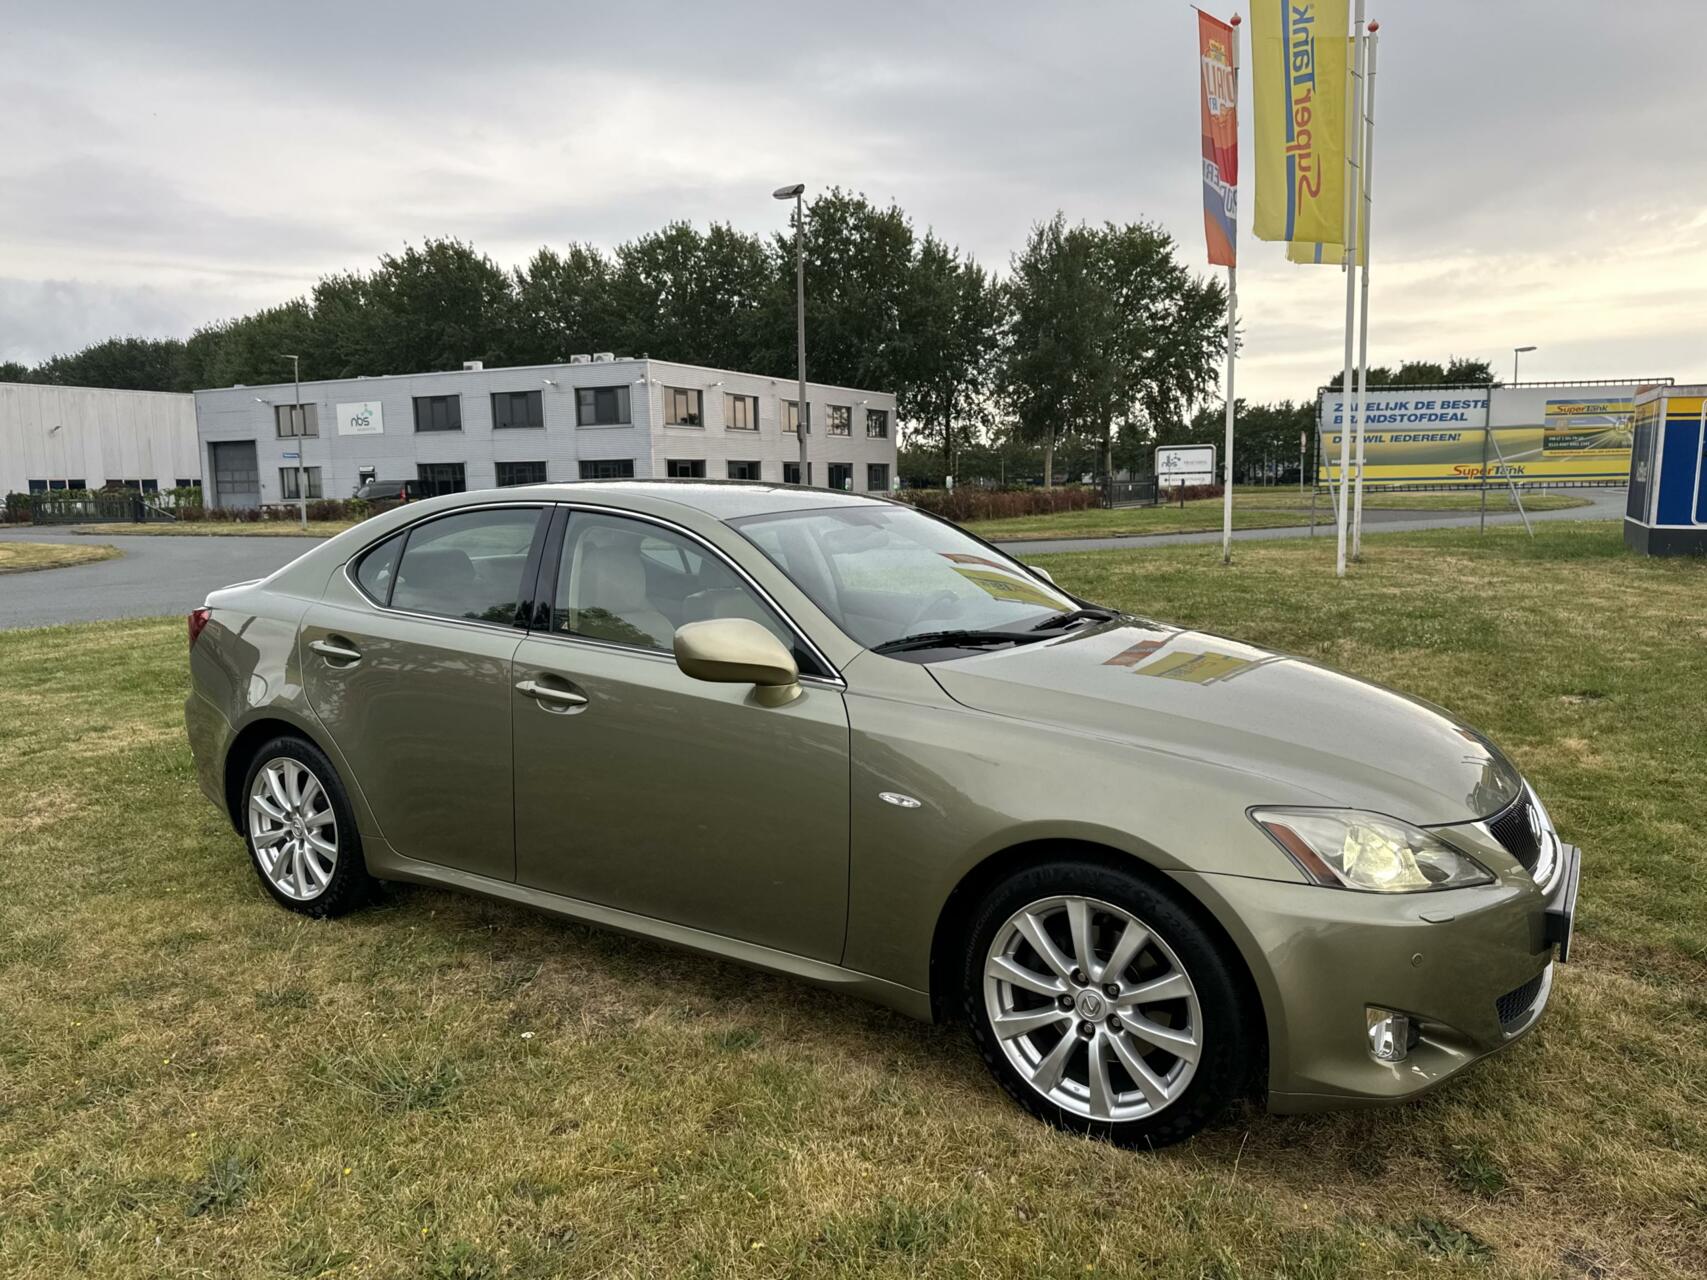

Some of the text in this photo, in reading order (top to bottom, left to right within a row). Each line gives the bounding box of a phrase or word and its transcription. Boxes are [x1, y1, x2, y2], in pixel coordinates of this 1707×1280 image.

[1414, 401, 1436, 411] DE
[1440, 399, 1489, 410] BESTE
[351, 415, 370, 426] nbs
[1333, 433, 1462, 444] DT WIL IEDEREEN!
